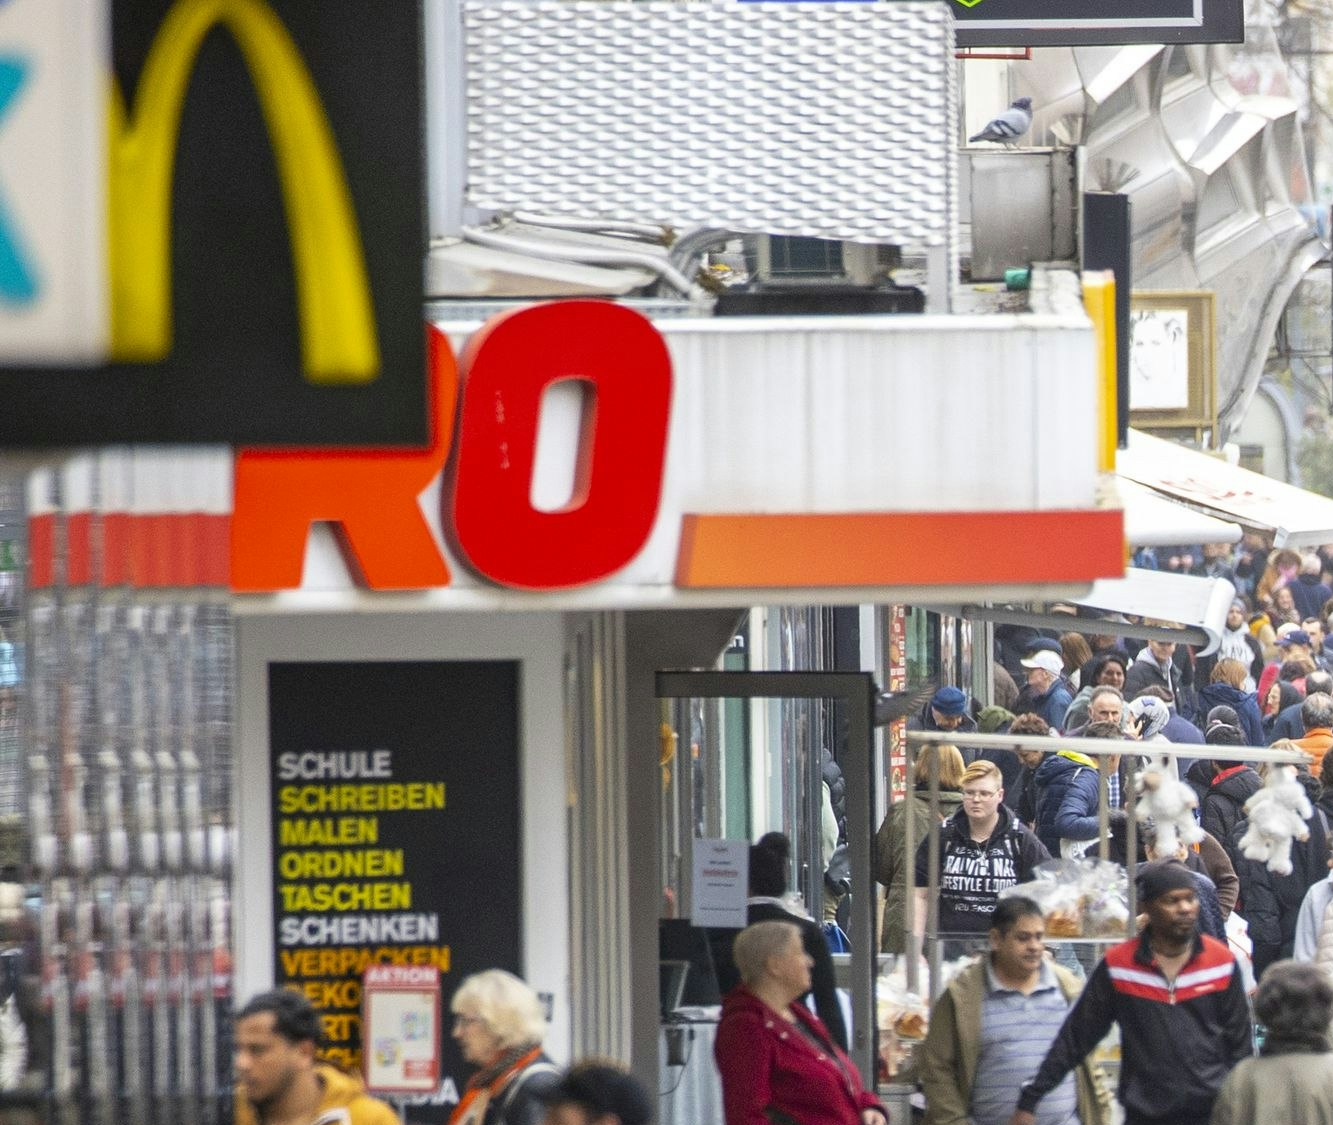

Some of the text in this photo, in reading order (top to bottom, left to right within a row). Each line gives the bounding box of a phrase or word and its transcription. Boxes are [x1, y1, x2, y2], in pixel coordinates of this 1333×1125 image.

[277, 750, 392, 780] SCHULE
[279, 781, 446, 813] SCHREIBEN
[280, 817, 379, 846] MALEN
[279, 848, 404, 879] ORDNEN
[279, 881, 412, 911] TASCHEN
[279, 912, 440, 945] SCHENKEN
[280, 945, 451, 977] VERPACKEN
